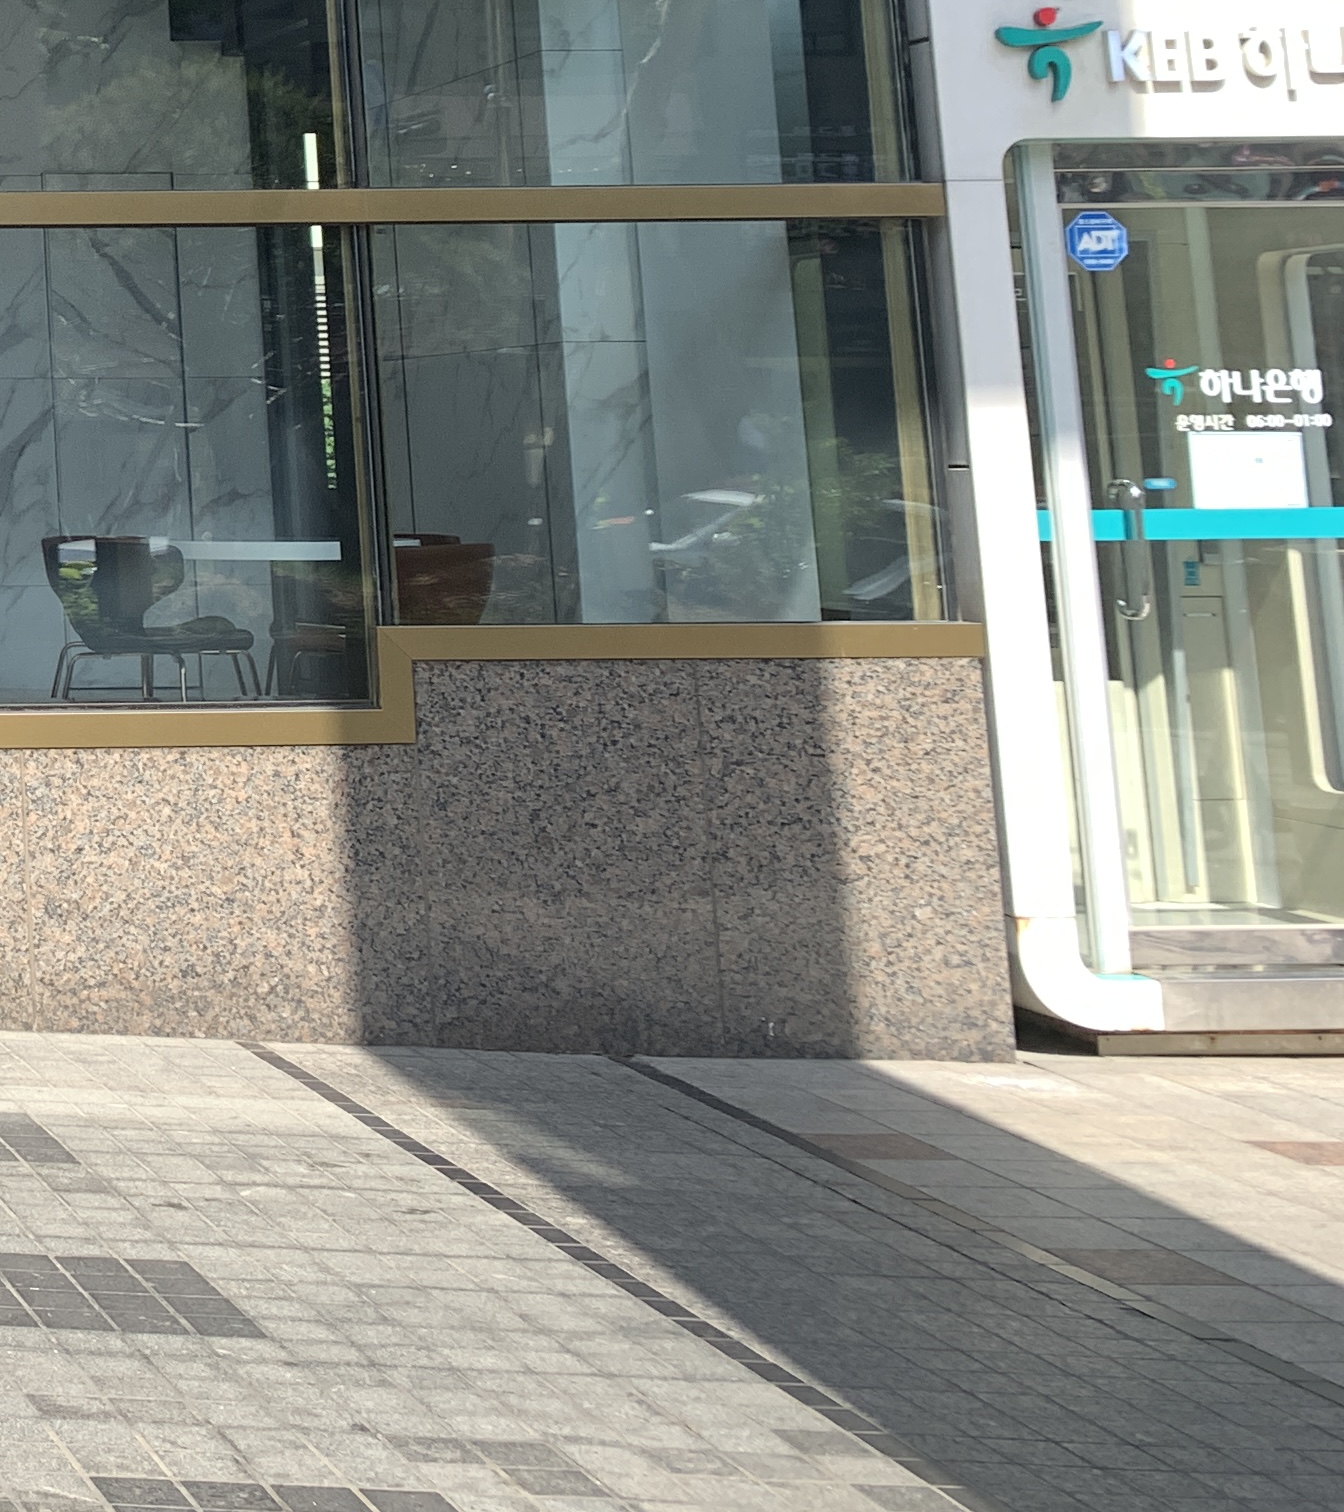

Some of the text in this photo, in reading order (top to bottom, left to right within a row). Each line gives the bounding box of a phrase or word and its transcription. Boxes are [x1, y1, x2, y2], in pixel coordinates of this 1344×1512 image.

[1077, 229, 1120, 252] ADT
[1198, 368, 1324, 404] 하나은행
[1175, 414, 1235, 432] 운영시간
